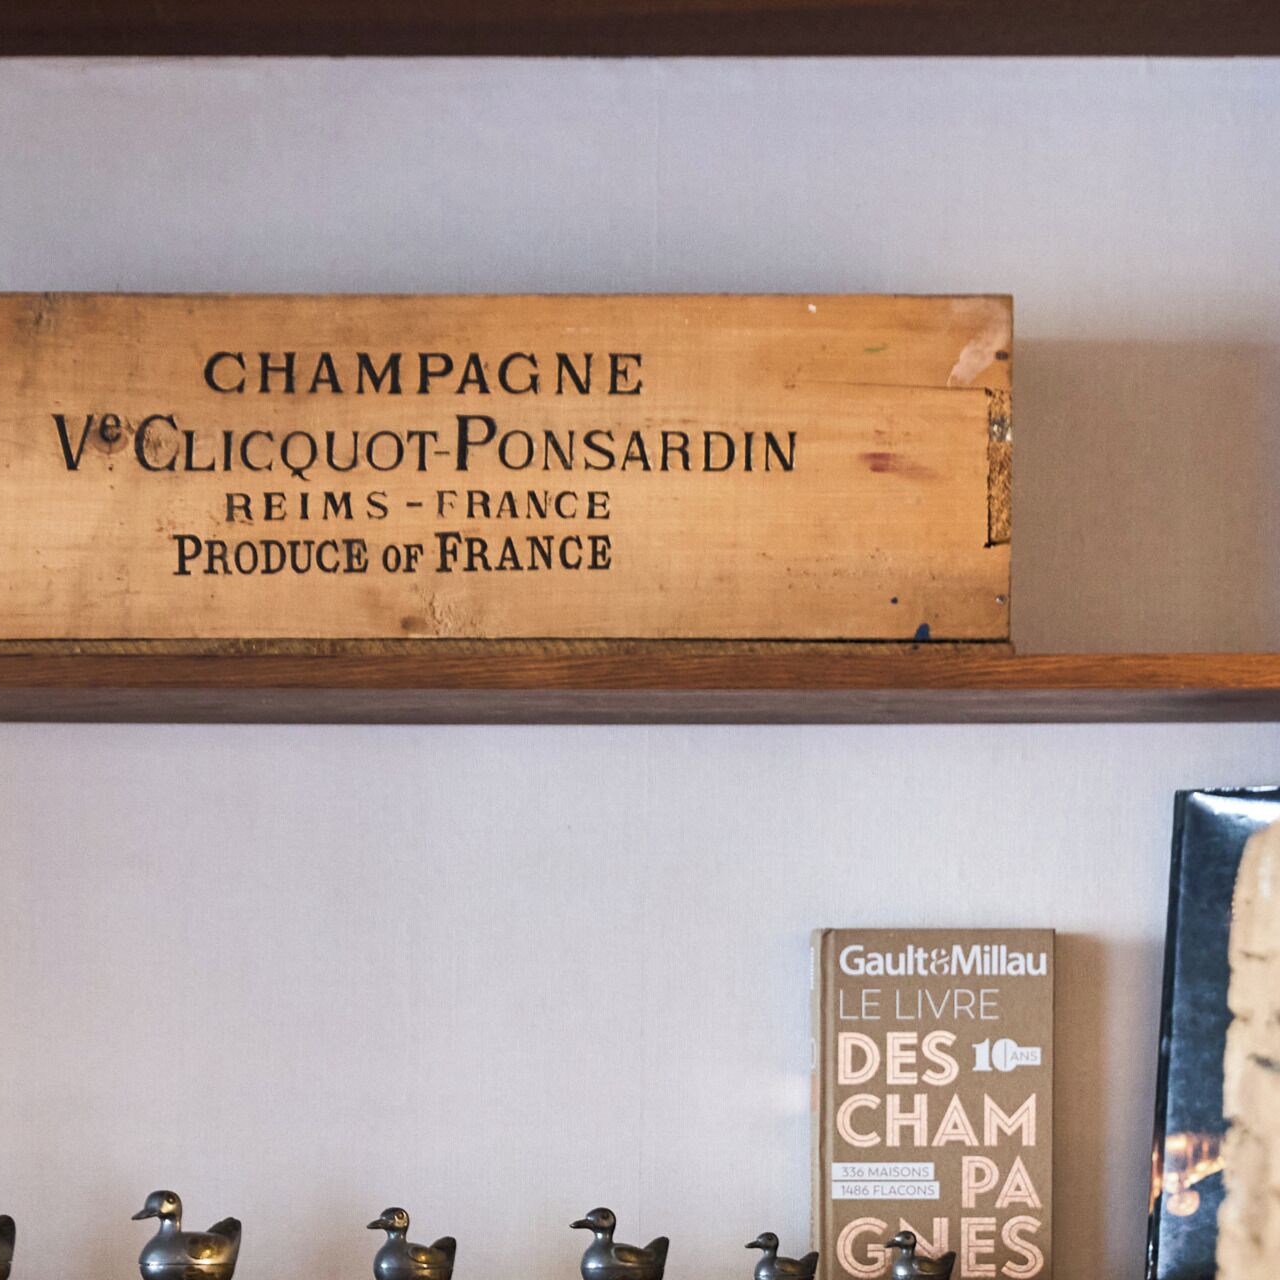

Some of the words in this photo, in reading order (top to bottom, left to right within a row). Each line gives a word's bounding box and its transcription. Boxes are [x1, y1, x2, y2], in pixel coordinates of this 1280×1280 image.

[204, 352, 642, 395] CHAMPAGNE
[226, 492, 388, 523] REIMS
[437, 491, 609, 519] FRANCE
[173, 535, 368, 575] PRODUCE
[435, 532, 611, 573] FRANCE
[839, 944, 1047, 976] Gault&Millau
[839, 989, 881, 1020] LE
[895, 989, 1000, 1020] LIVRE
[838, 1030, 960, 1086] DES
[972, 1038, 1018, 1072] 10
[1010, 1050, 1038, 1062] ANS
[836, 1093, 1036, 1147] CHAM
[841, 1166, 864, 1177] 336
[867, 1166, 929, 1177] MAISONS
[961, 1155, 1043, 1209] PA
[841, 1185, 869, 1196] 1486
[873, 1185, 935, 1196] FLACONS
